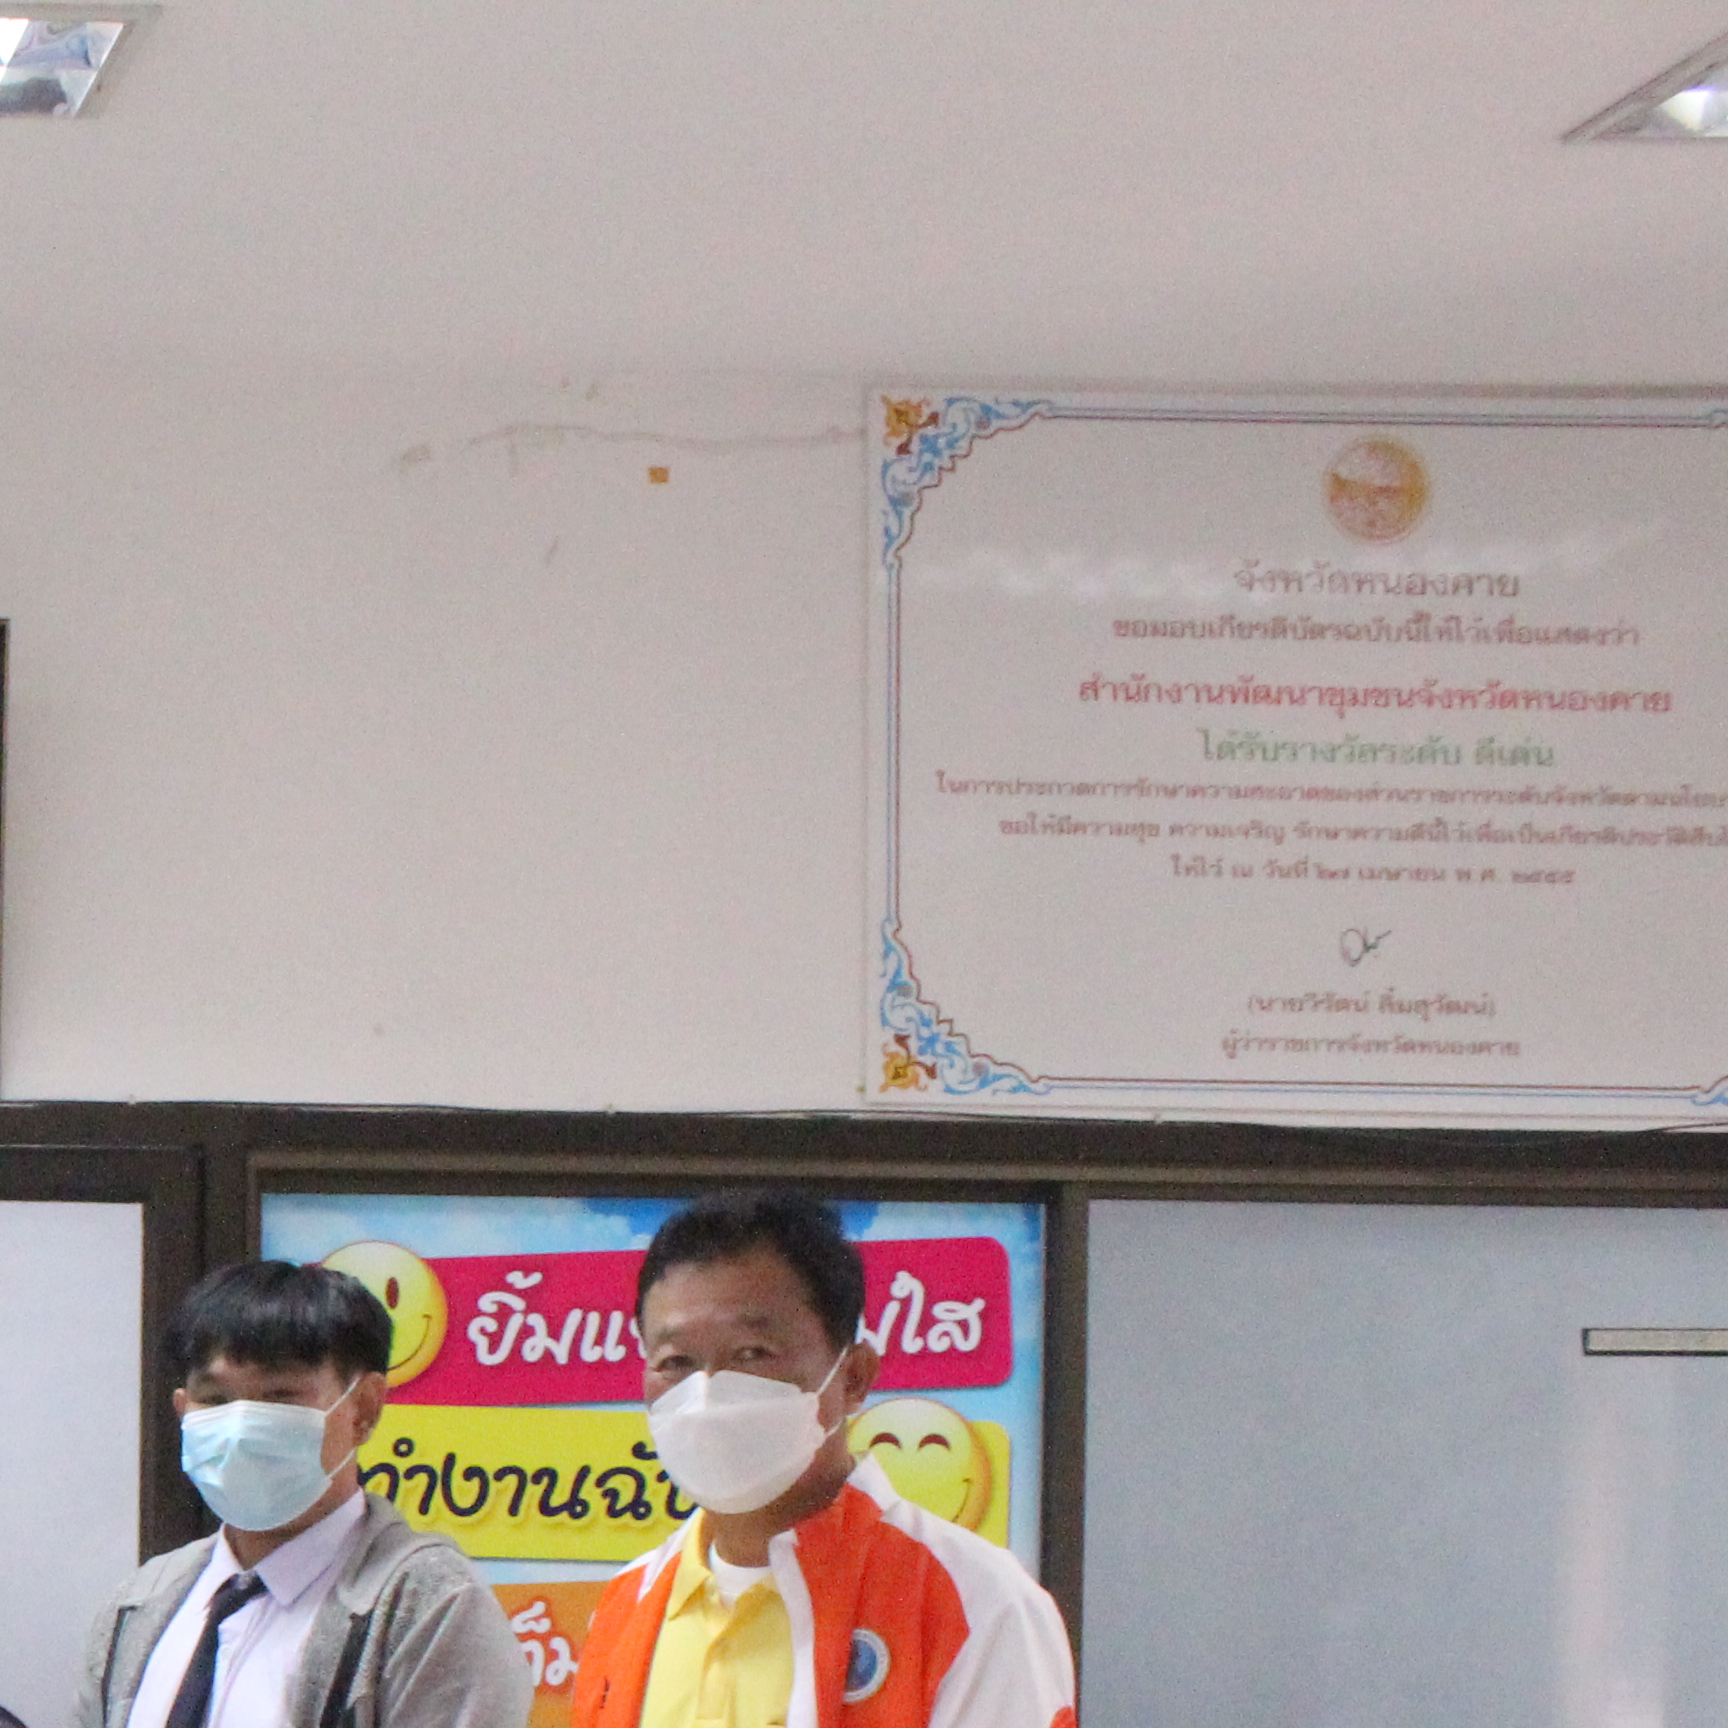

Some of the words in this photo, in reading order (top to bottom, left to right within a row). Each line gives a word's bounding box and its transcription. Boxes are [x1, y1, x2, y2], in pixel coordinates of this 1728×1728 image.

[1234, 560, 1520, 598] จังหวัดหนองคาย
[1079, 673, 1673, 718] สำนักงานพัฒนาชุมชนจังหวัดหนองคาย
[467, 1270, 647, 1366] ยิ้มแ
